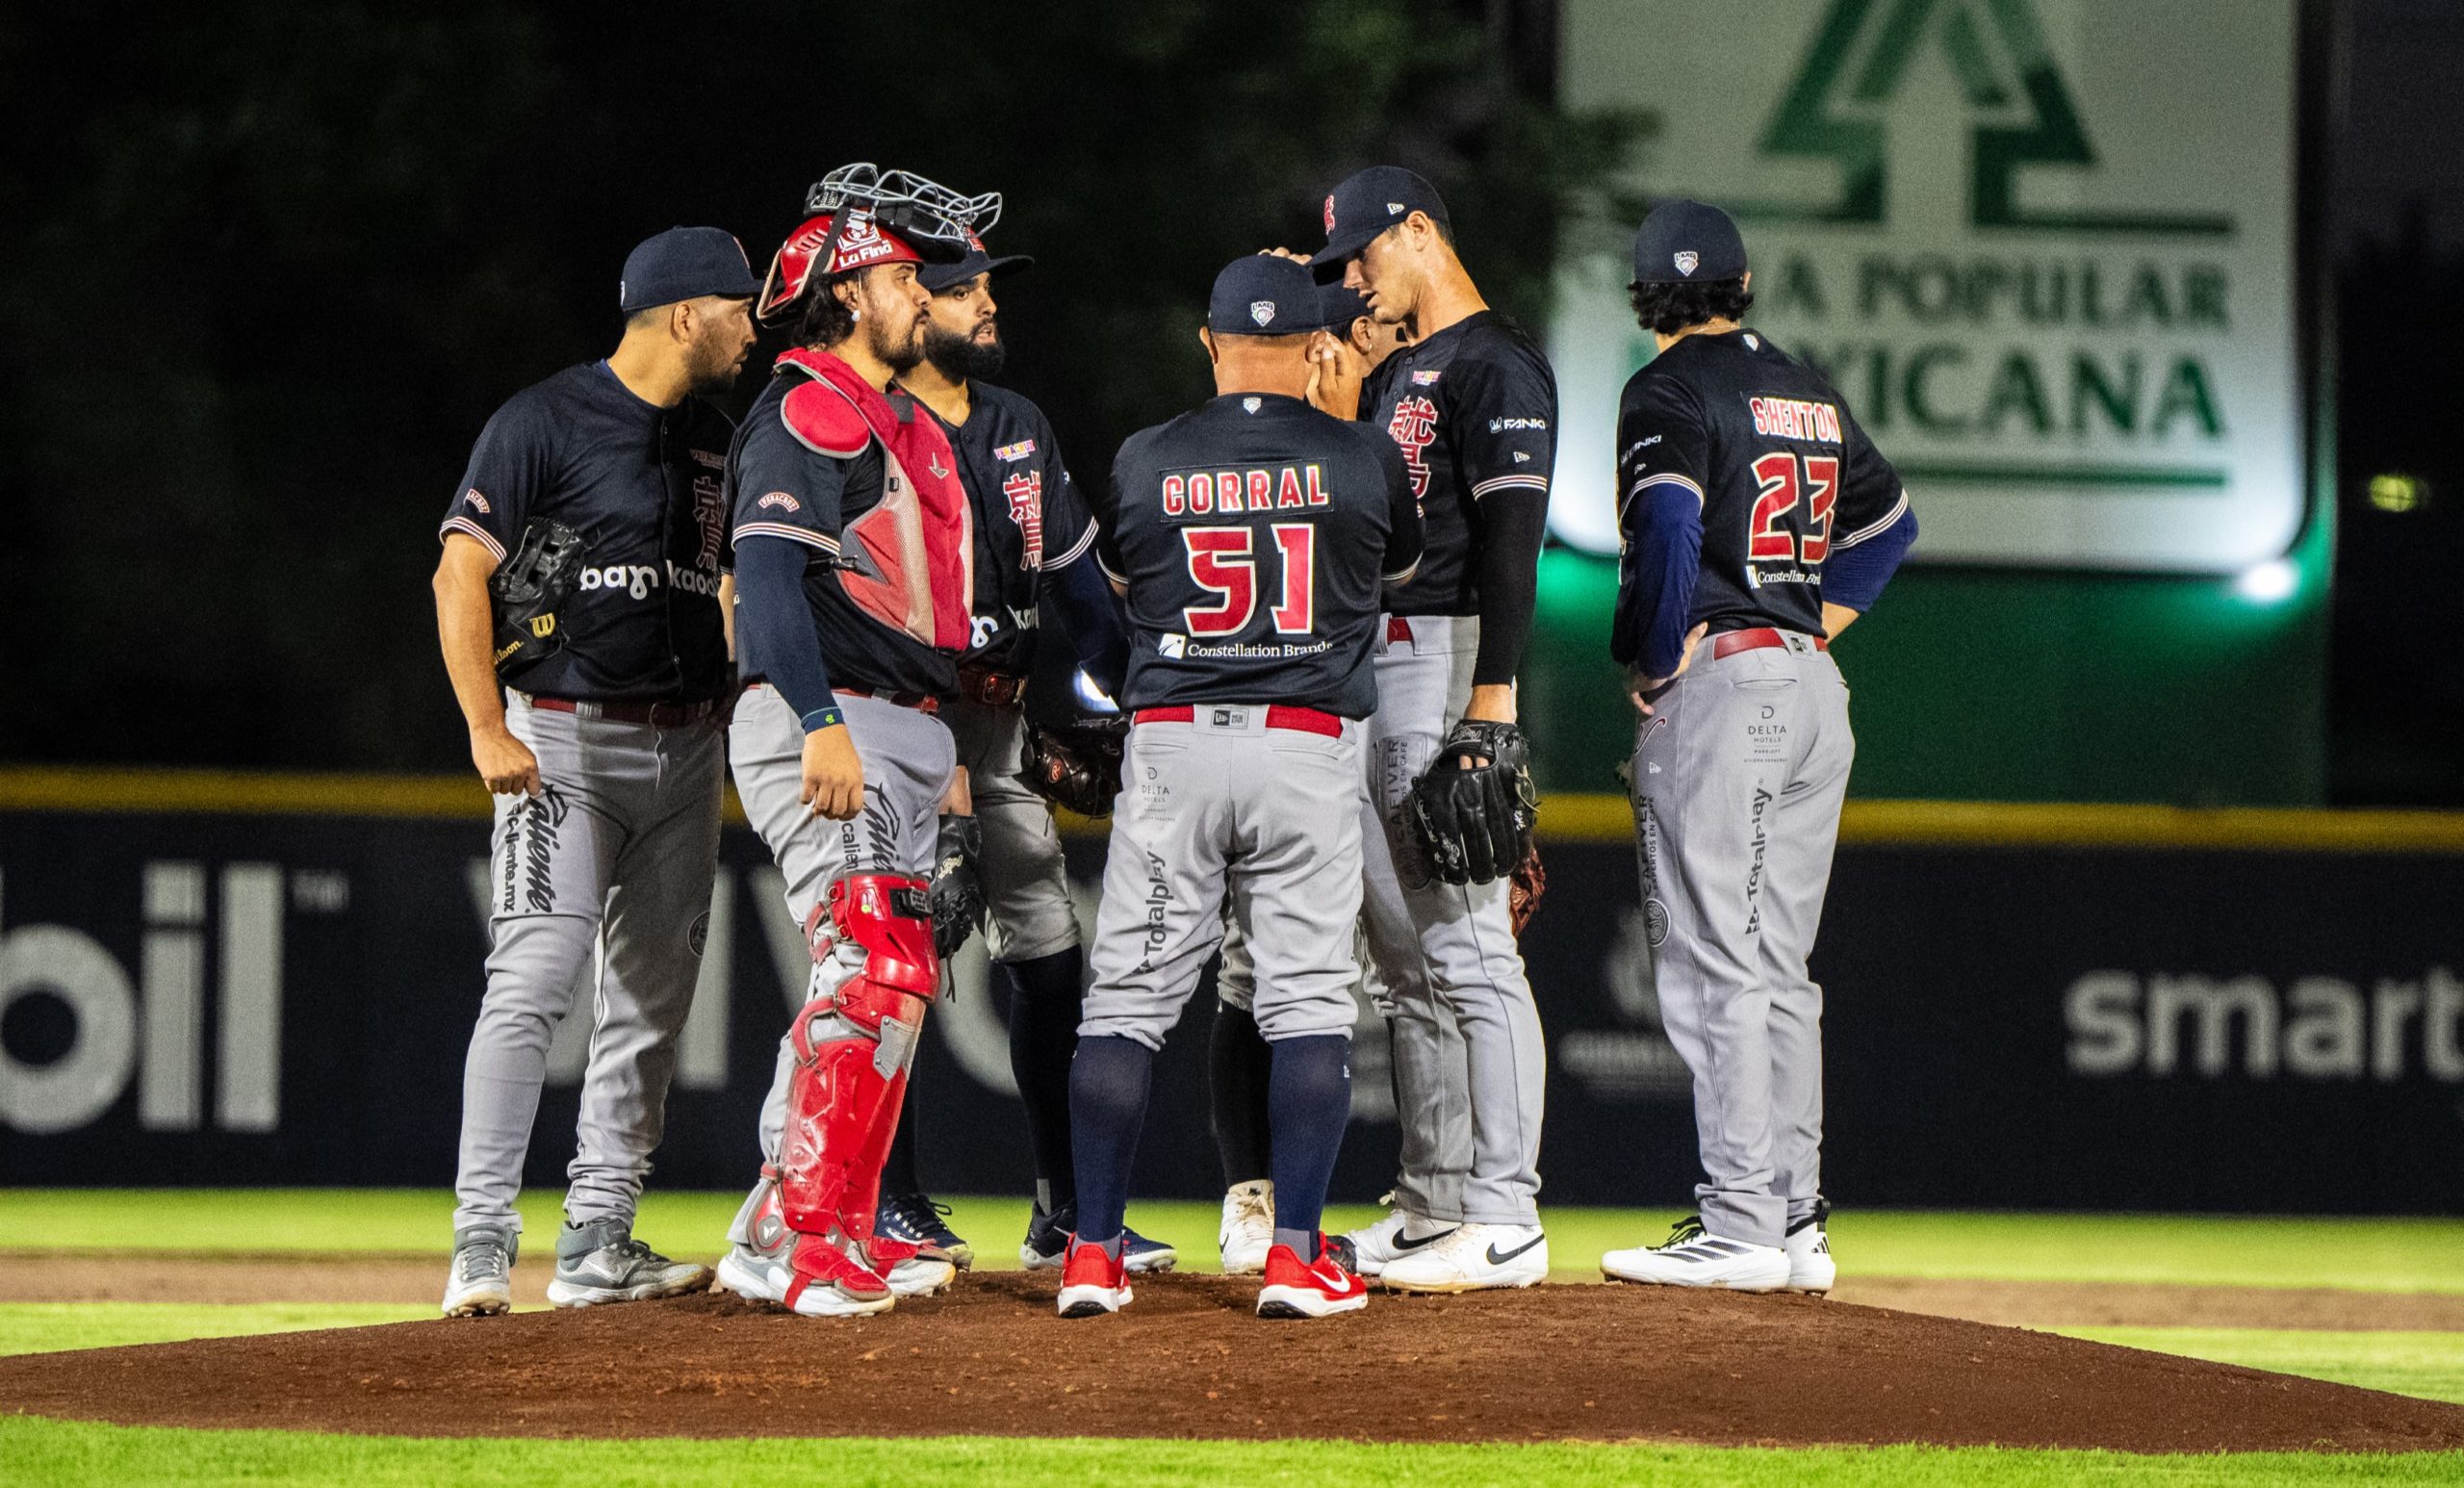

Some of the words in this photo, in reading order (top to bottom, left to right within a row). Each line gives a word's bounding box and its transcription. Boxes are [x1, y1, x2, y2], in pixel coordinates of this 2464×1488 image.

[1860, 260, 2229, 327] POPULAR
[1749, 398, 1842, 444] SHENTON
[1163, 465, 1329, 516] CORRAL
[1747, 452, 1838, 565] 23
[1181, 524, 1315, 637] 51
[1187, 643, 1281, 657] Constellation
[1748, 725, 1787, 735] DELTA
[1142, 784, 1170, 795] DELTA
